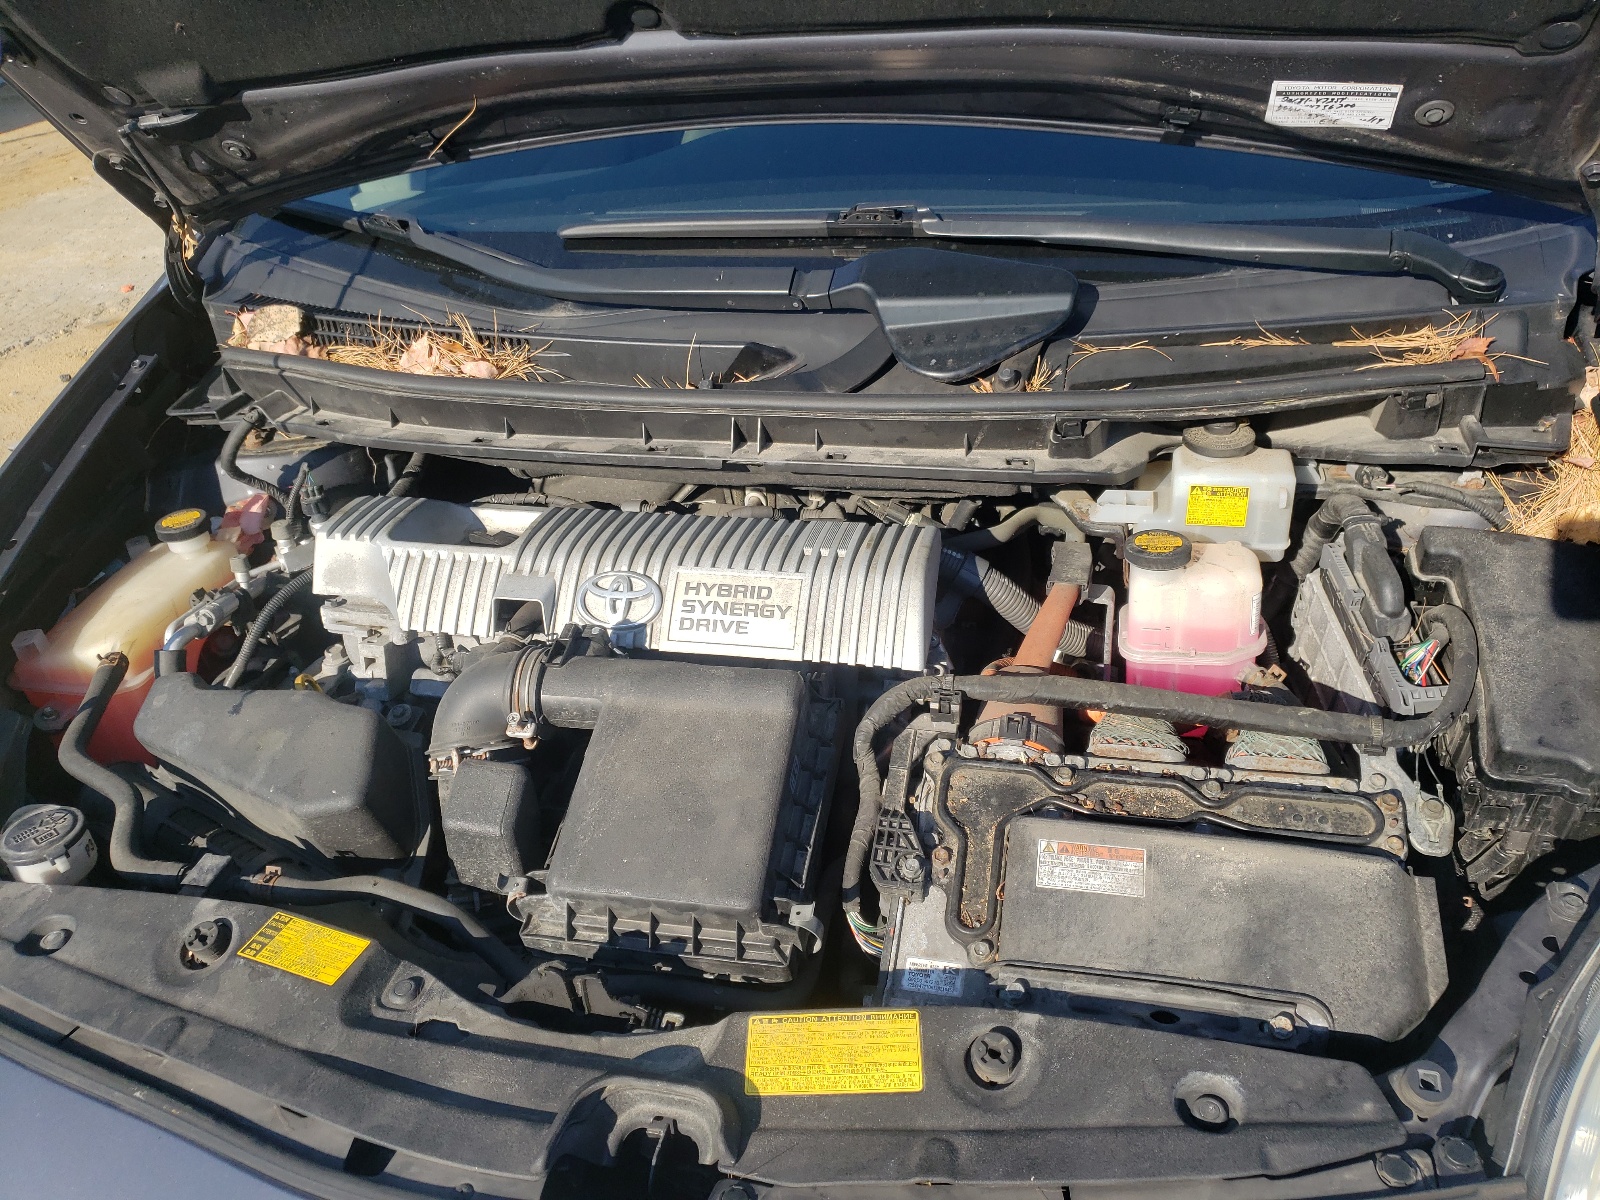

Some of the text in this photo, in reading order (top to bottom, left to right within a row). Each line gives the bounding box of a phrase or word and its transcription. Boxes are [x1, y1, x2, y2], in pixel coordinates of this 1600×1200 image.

[684, 581, 772, 600] HYBRID
[681, 599, 793, 619] SYNERGY
[678, 616, 749, 634] DRIVE
[782, 1016, 818, 1024] CAUTION
[821, 1014, 867, 1022] ATTENTION
